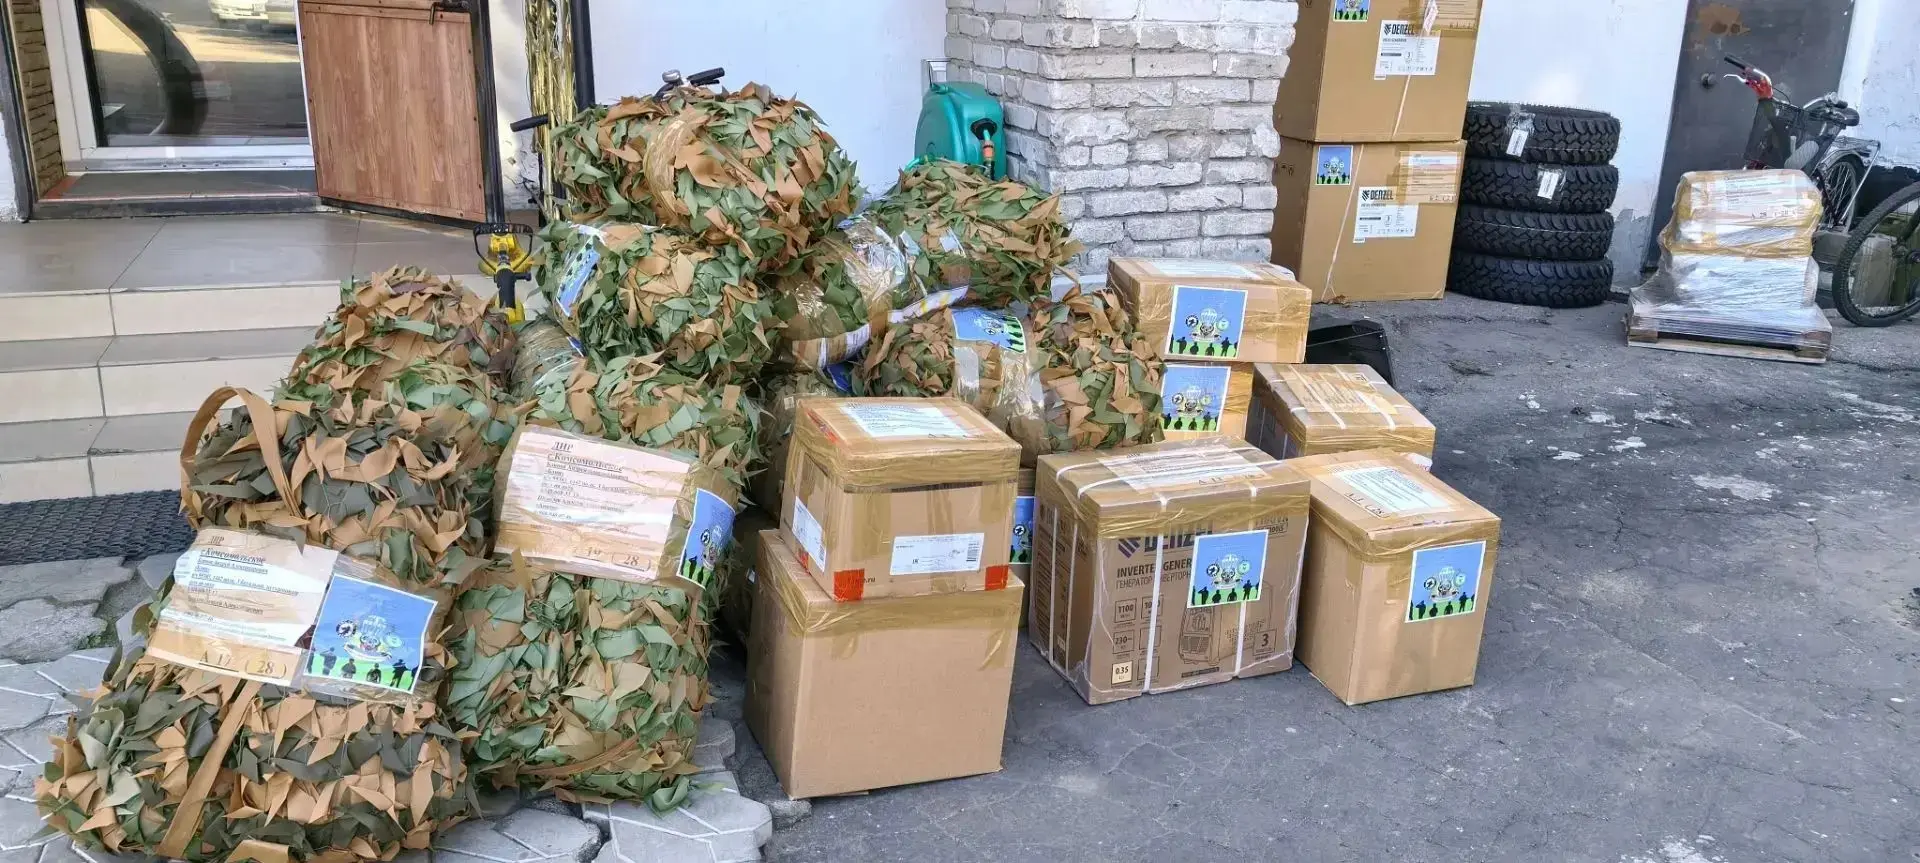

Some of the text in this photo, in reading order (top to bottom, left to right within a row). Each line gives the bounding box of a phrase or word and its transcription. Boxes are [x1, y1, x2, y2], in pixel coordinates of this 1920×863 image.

[1391, 23, 1415, 35] DENZEL
[1370, 189, 1394, 200] DENZEL
[624, 555, 640, 566] 28
[1116, 558, 1192, 579] INVERTE GENER
[1261, 633, 1269, 647] 3
[257, 660, 275, 675] 28
